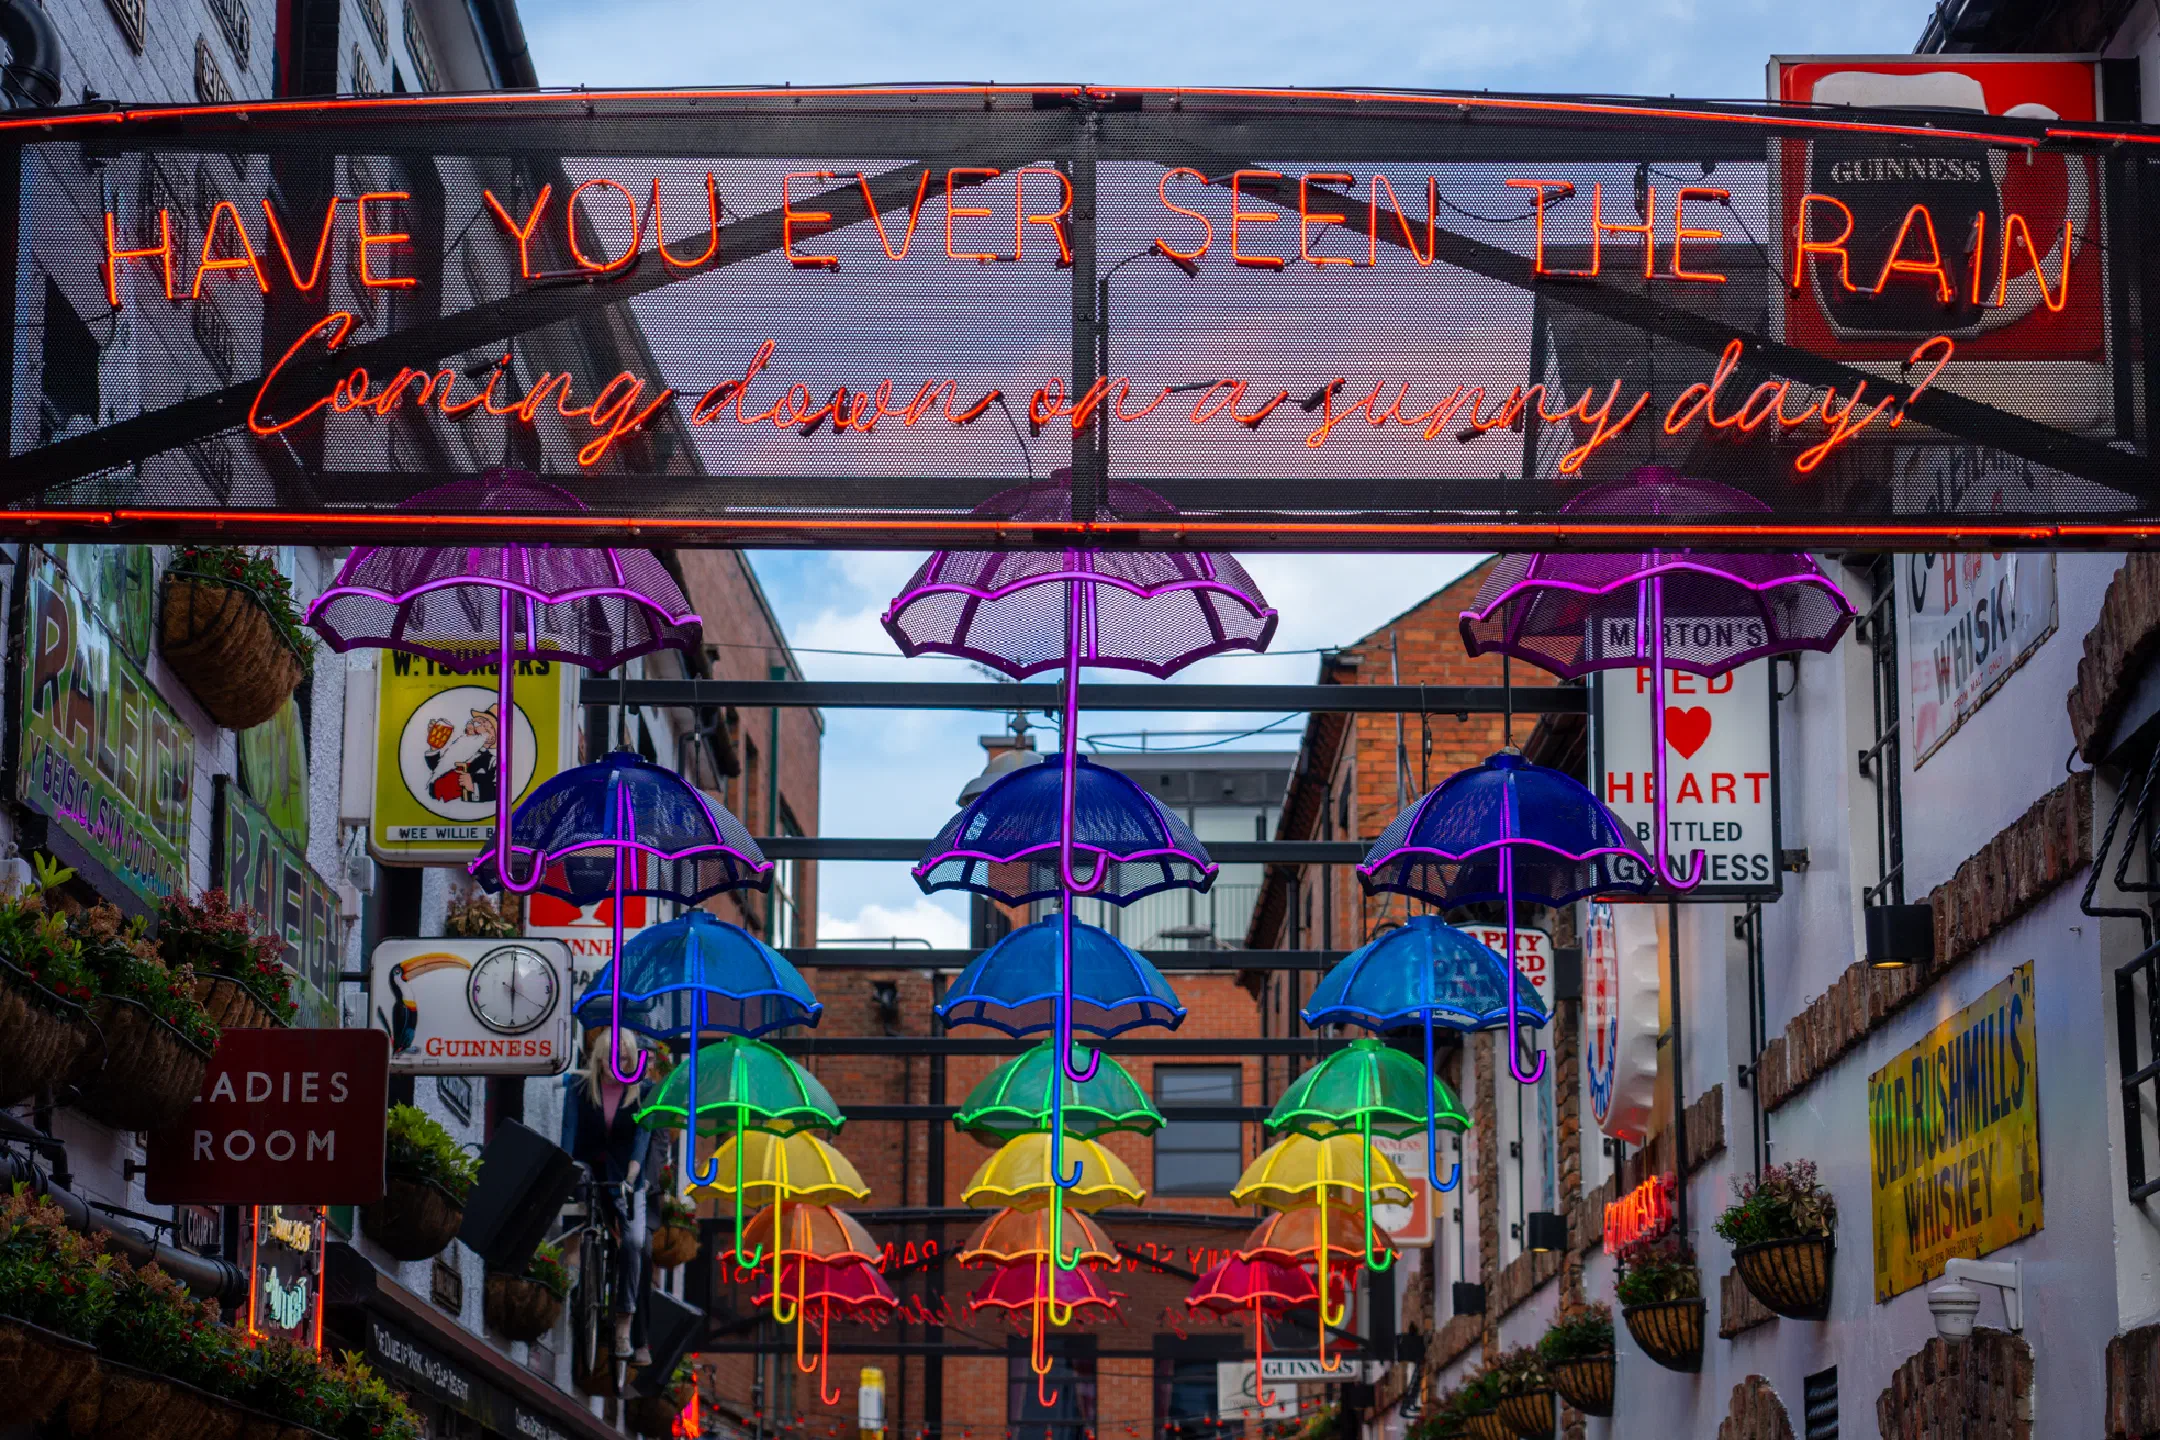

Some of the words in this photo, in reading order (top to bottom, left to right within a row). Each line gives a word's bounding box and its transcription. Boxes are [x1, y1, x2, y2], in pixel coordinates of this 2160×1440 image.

[1831, 158, 1981, 184] GUINNESS
[104, 192, 417, 308] HAVE
[483, 170, 720, 280] YOU
[783, 167, 1073, 266] EVER
[1155, 167, 1436, 267] SEEN
[1505, 178, 1731, 283] THE
[1792, 192, 2074, 312] RAIN
[247, 311, 662, 467] Coming
[691, 338, 1001, 432] down
[1029, 376, 1169, 429] on
[1191, 378, 1289, 424] a
[1305, 375, 1650, 475] sunny
[1664, 335, 1955, 474] day?
[1970, 672, 1984, 692] MALT
[31, 576, 191, 875] RALEIGH
[29, 728, 42, 784] Y
[400, 827, 427, 839] WEE
[436, 827, 478, 839] WILLIE
[1637, 822, 1742, 842] BTTLED
[1614, 854, 1769, 882] GNESS
[229, 802, 339, 1006] RALEIGH
[425, 1037, 552, 1057] GUINNESS
[192, 1071, 349, 1103] ADIES
[193, 1129, 335, 1162] ROOM
[1903, 1142, 1994, 1256] WHISKEY
